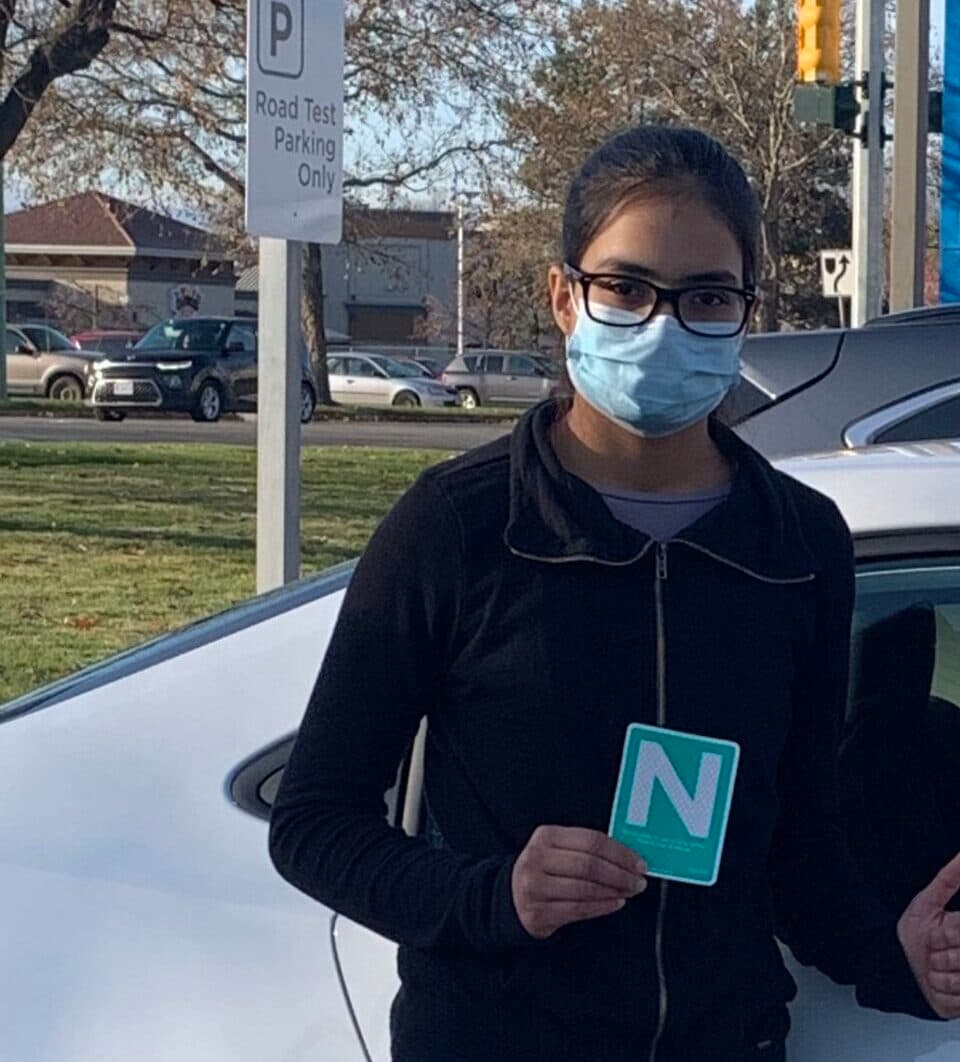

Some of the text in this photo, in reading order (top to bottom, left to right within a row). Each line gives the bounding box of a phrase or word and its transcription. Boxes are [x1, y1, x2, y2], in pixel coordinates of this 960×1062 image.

[270, 1, 293, 57] P
[255, 90, 337, 126] Road Test
[274, 126, 337, 162] Parking
[298, 163, 336, 195] Only
[626, 739, 723, 838] N
